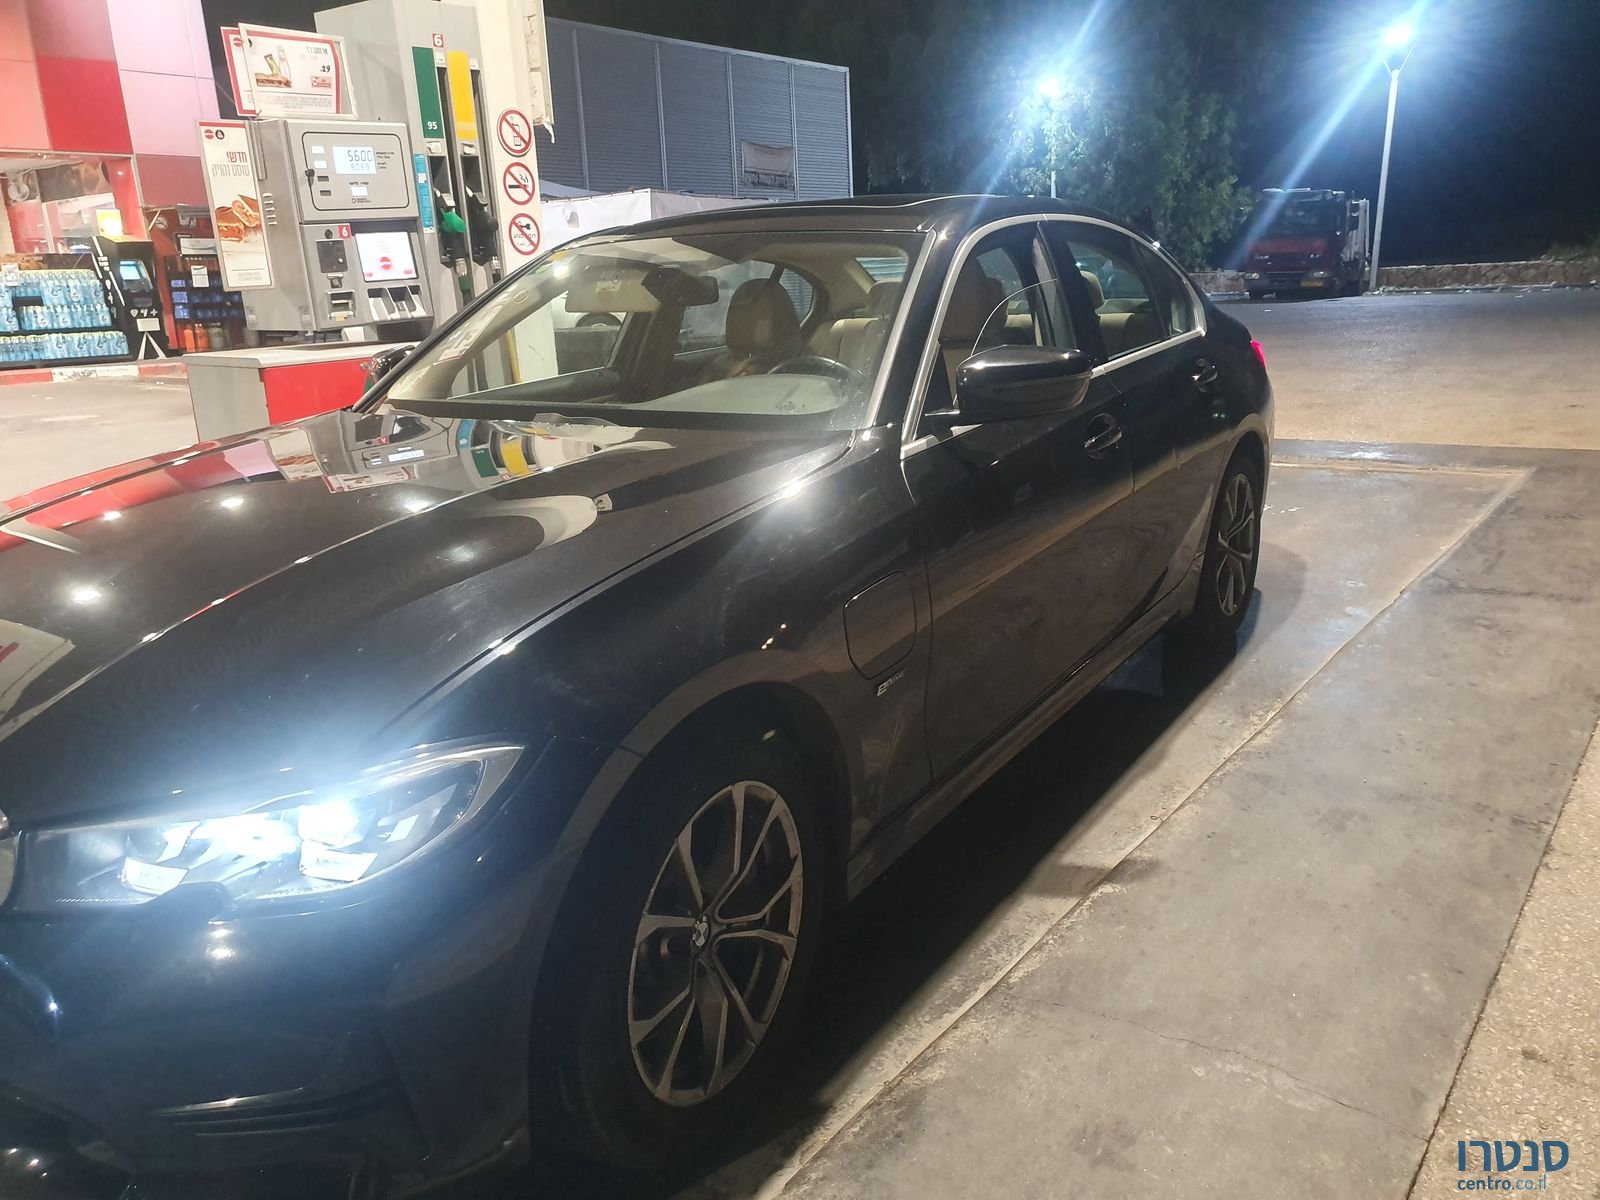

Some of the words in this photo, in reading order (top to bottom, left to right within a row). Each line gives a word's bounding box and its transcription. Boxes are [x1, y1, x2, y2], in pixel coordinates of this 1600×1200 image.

[434, 34, 442, 47] 6
[427, 121, 438, 130] 95
[226, 151, 248, 163] חדש!
[342, 226, 348, 237] 6
